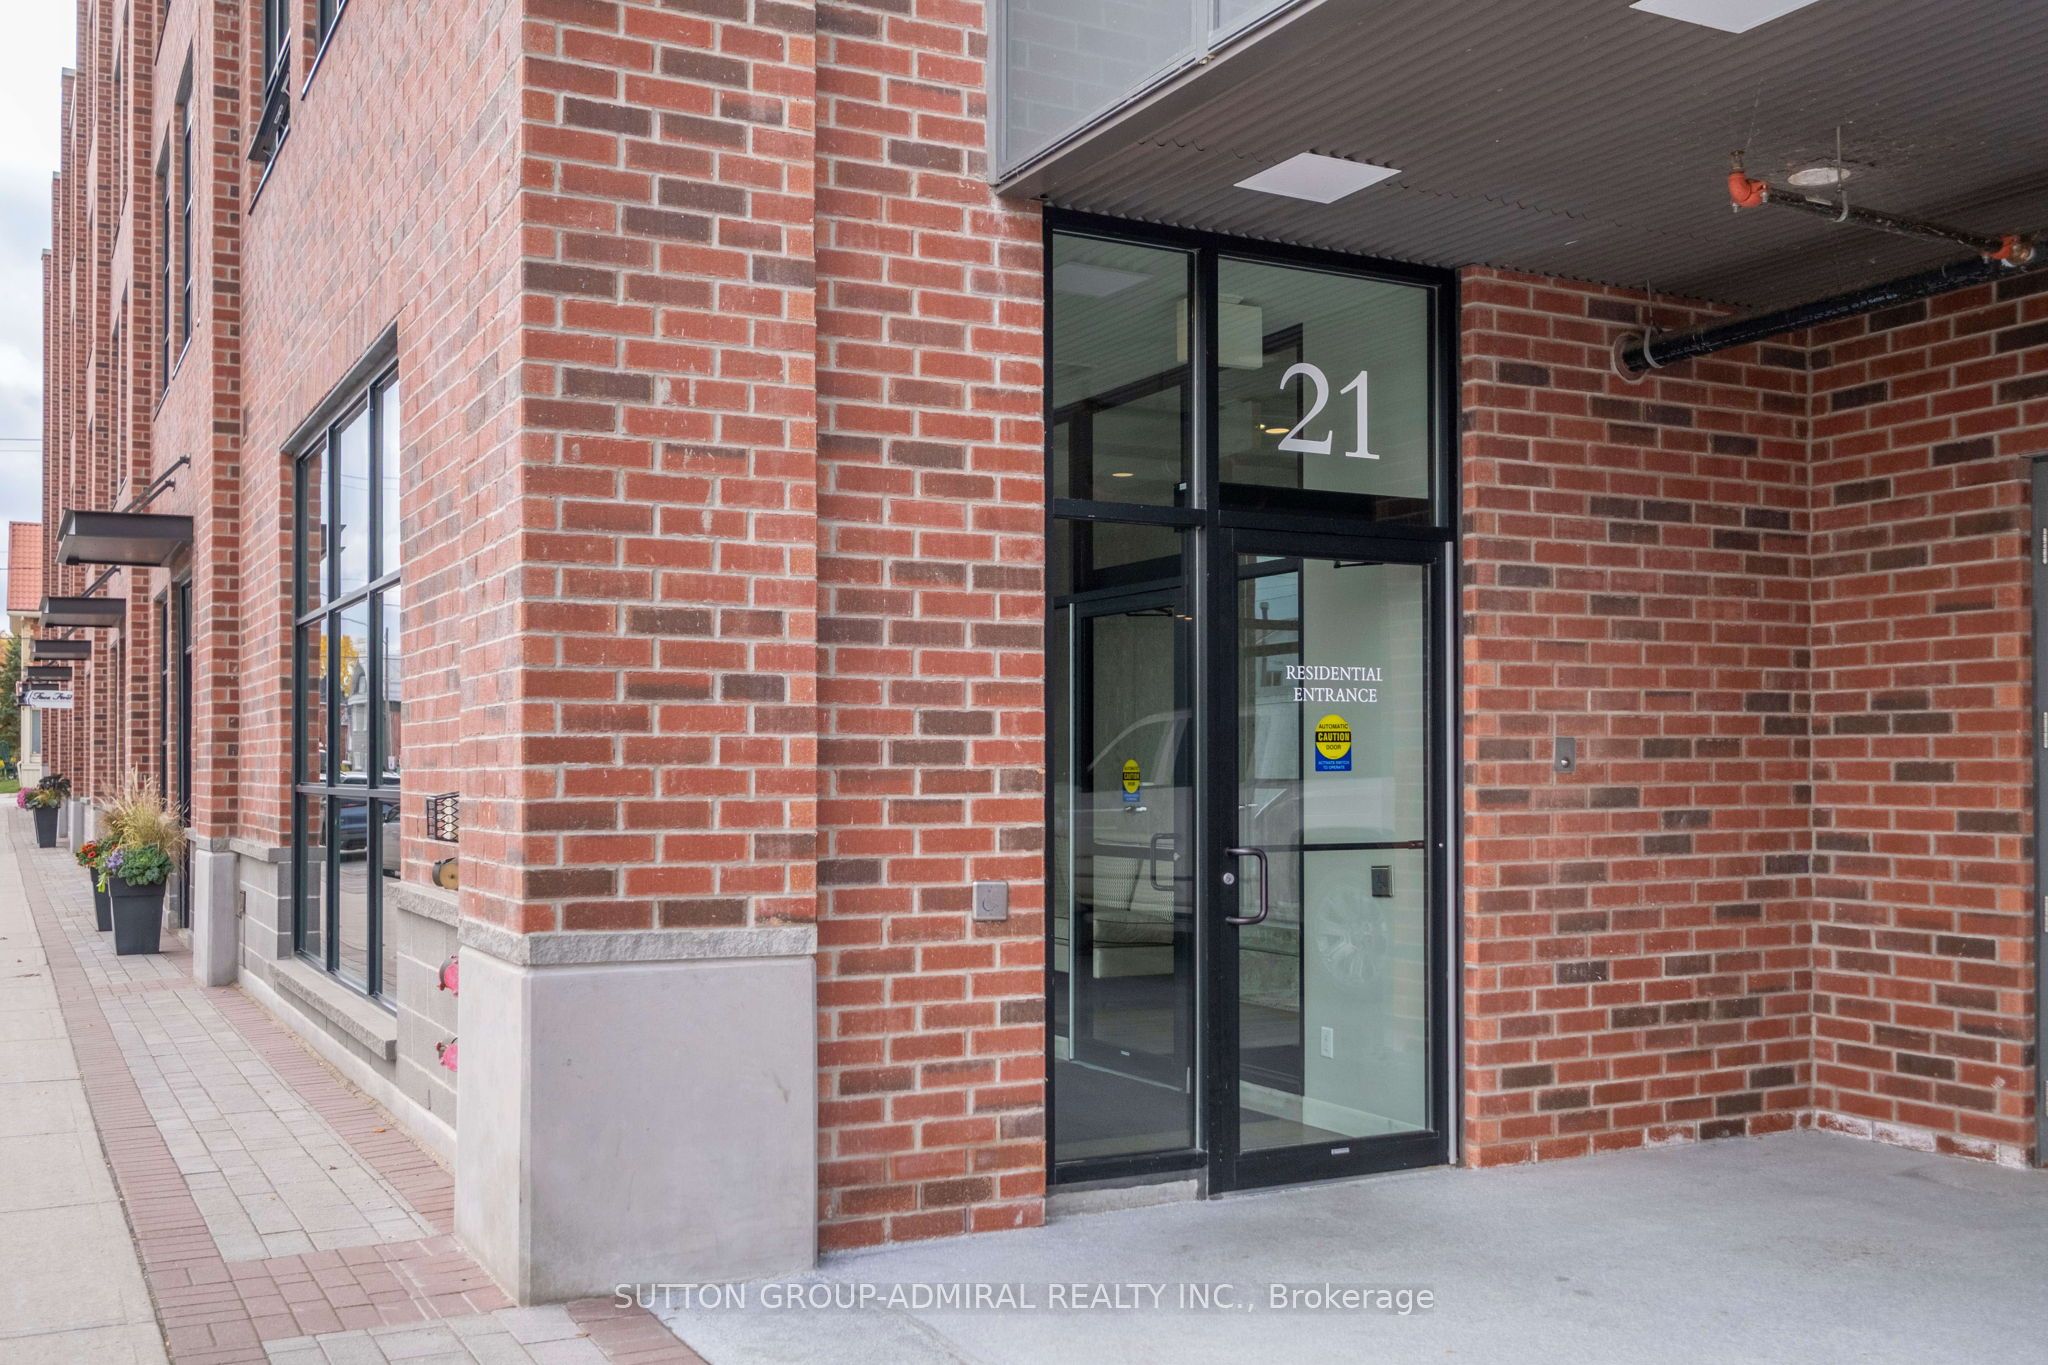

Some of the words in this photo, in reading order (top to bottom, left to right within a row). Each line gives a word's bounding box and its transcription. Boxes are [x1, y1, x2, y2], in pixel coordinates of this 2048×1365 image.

[1278, 362, 1380, 460] 21
[1286, 665, 1383, 681] RESIDENTIAL
[1293, 687, 1378, 703] ENTRANCE
[1317, 732, 1350, 741] CAUTION
